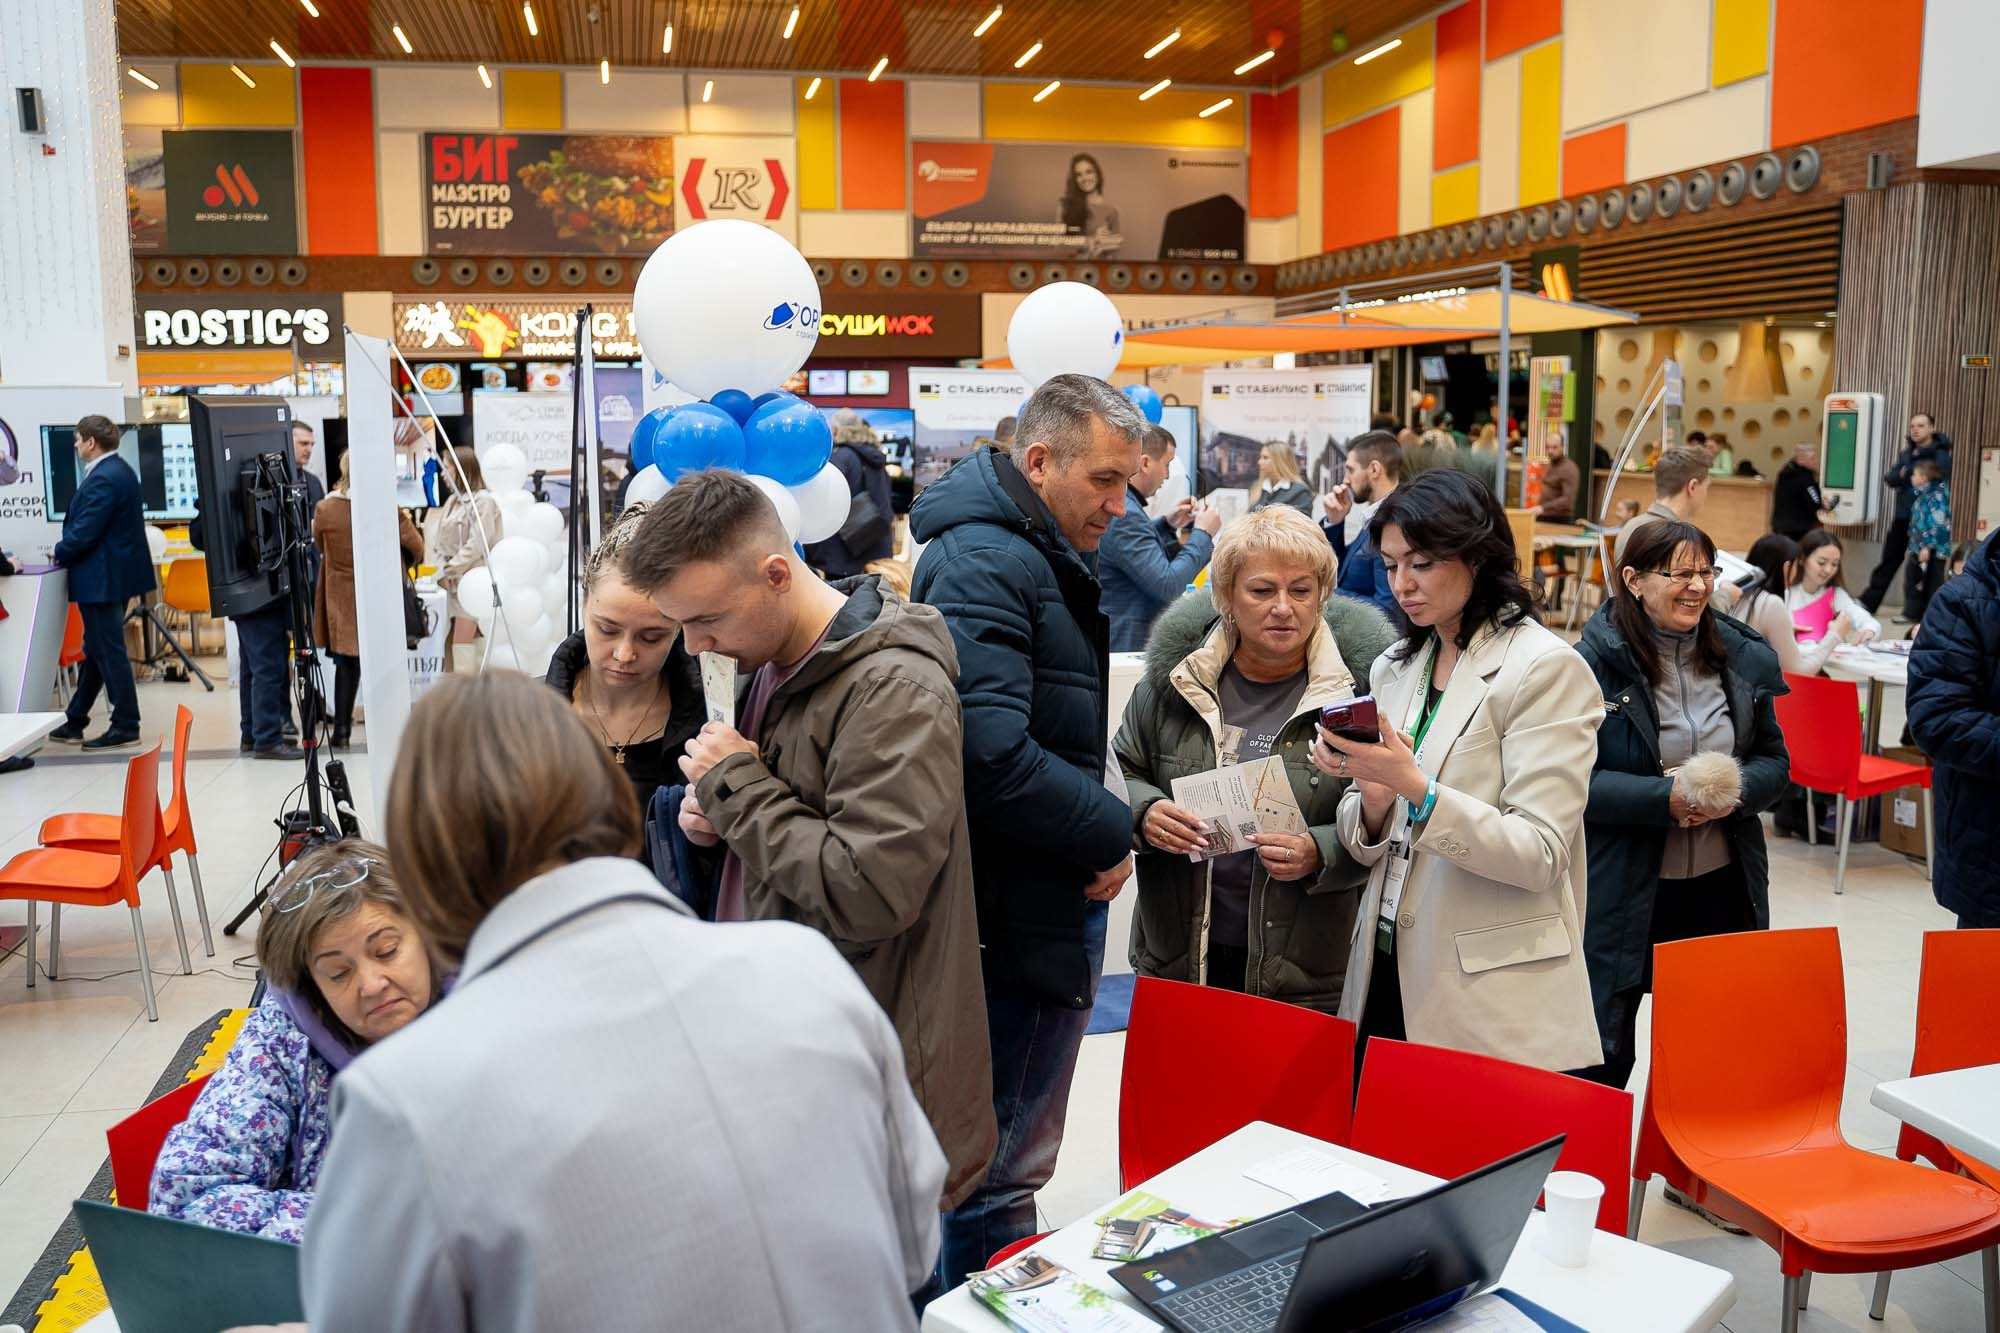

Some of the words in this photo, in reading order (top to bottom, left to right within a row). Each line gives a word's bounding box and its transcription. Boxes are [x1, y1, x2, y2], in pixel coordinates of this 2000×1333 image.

[432, 136, 519, 183] БИГ
[432, 184, 511, 203] МАЭСТРО
[432, 205, 514, 230] БУРГЕР
[144, 308, 330, 346] ROSTIC'S
[947, 384, 1025, 395] СТАБИЛИС
[1235, 384, 1309, 395] СТАБИЛИС
[486, 431, 529, 443] КОГДА
[534, 448, 569, 462] ДОМ
